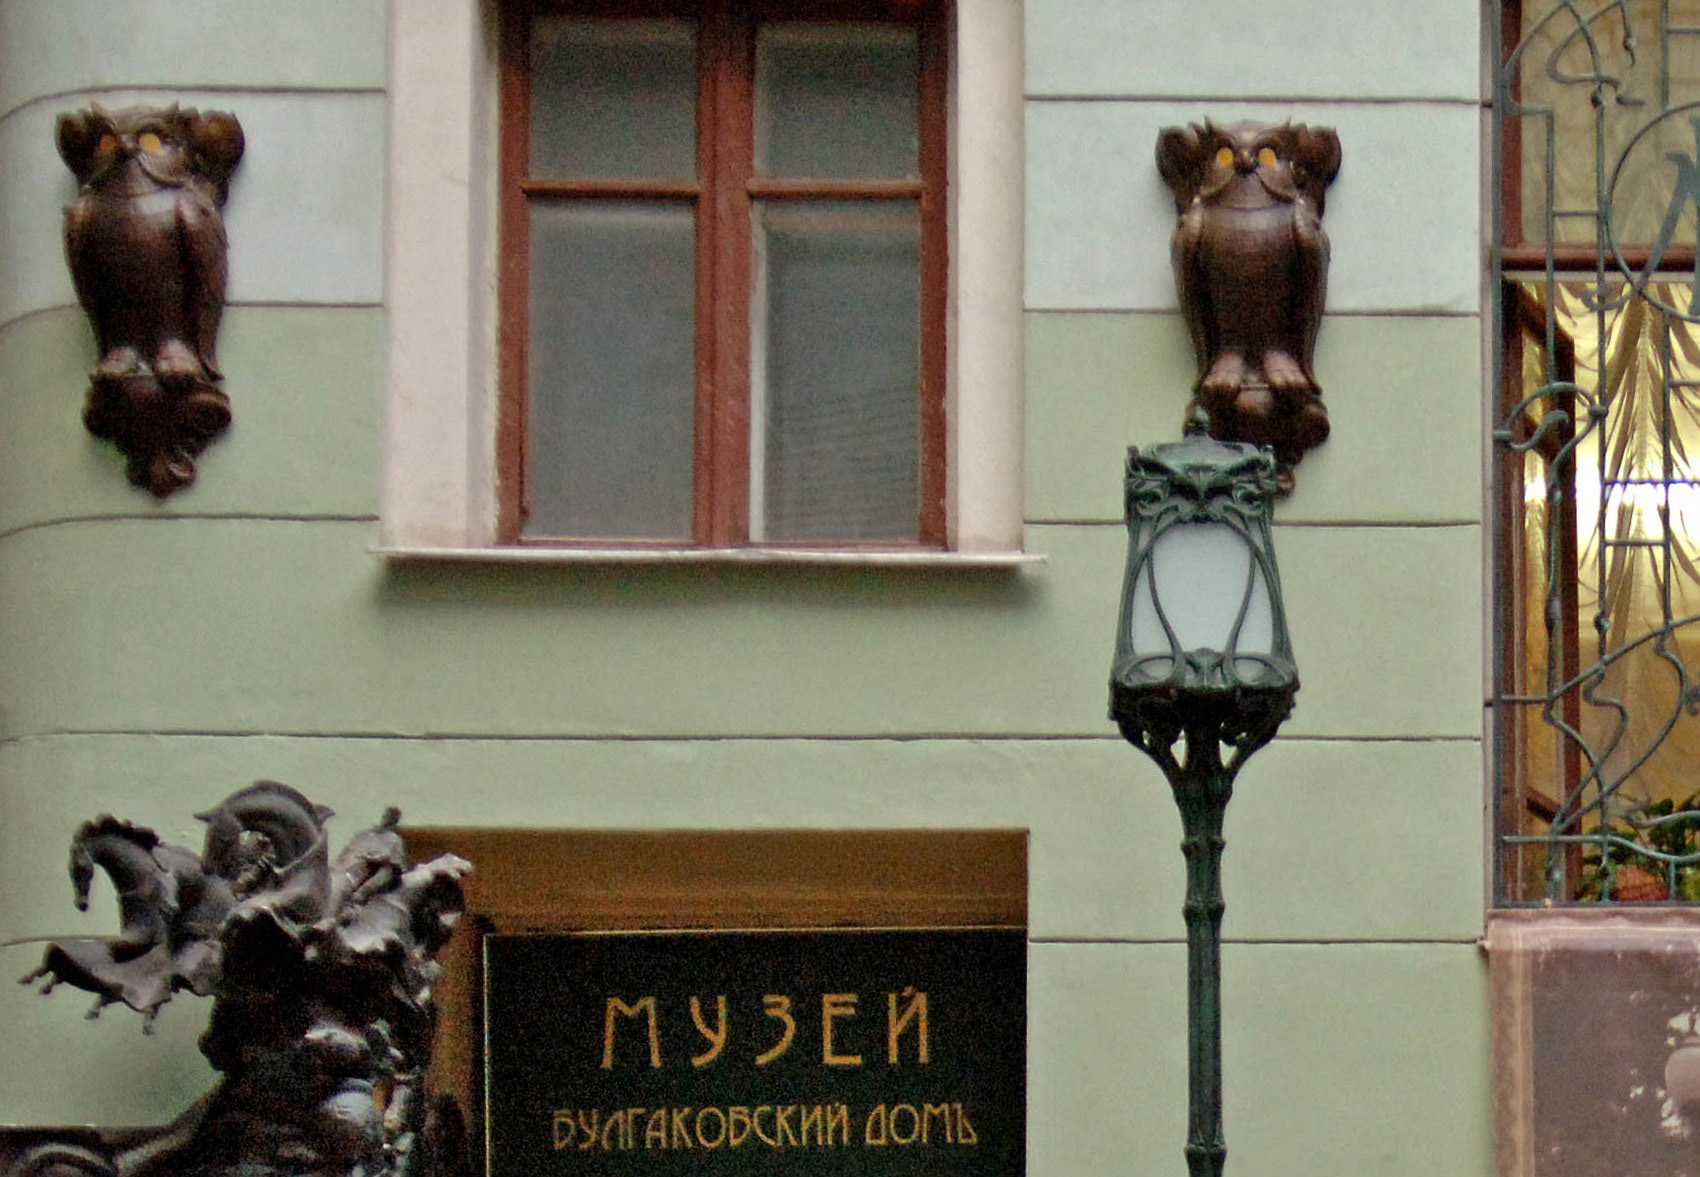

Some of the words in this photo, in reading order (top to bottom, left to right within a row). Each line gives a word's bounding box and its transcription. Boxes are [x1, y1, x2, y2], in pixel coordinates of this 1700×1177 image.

[600, 986, 929, 1069] МУЗЕЙ
[553, 1102, 850, 1150] БУЛГАКОВСКИЙ
[865, 1102, 979, 1146] ДОМЪ
